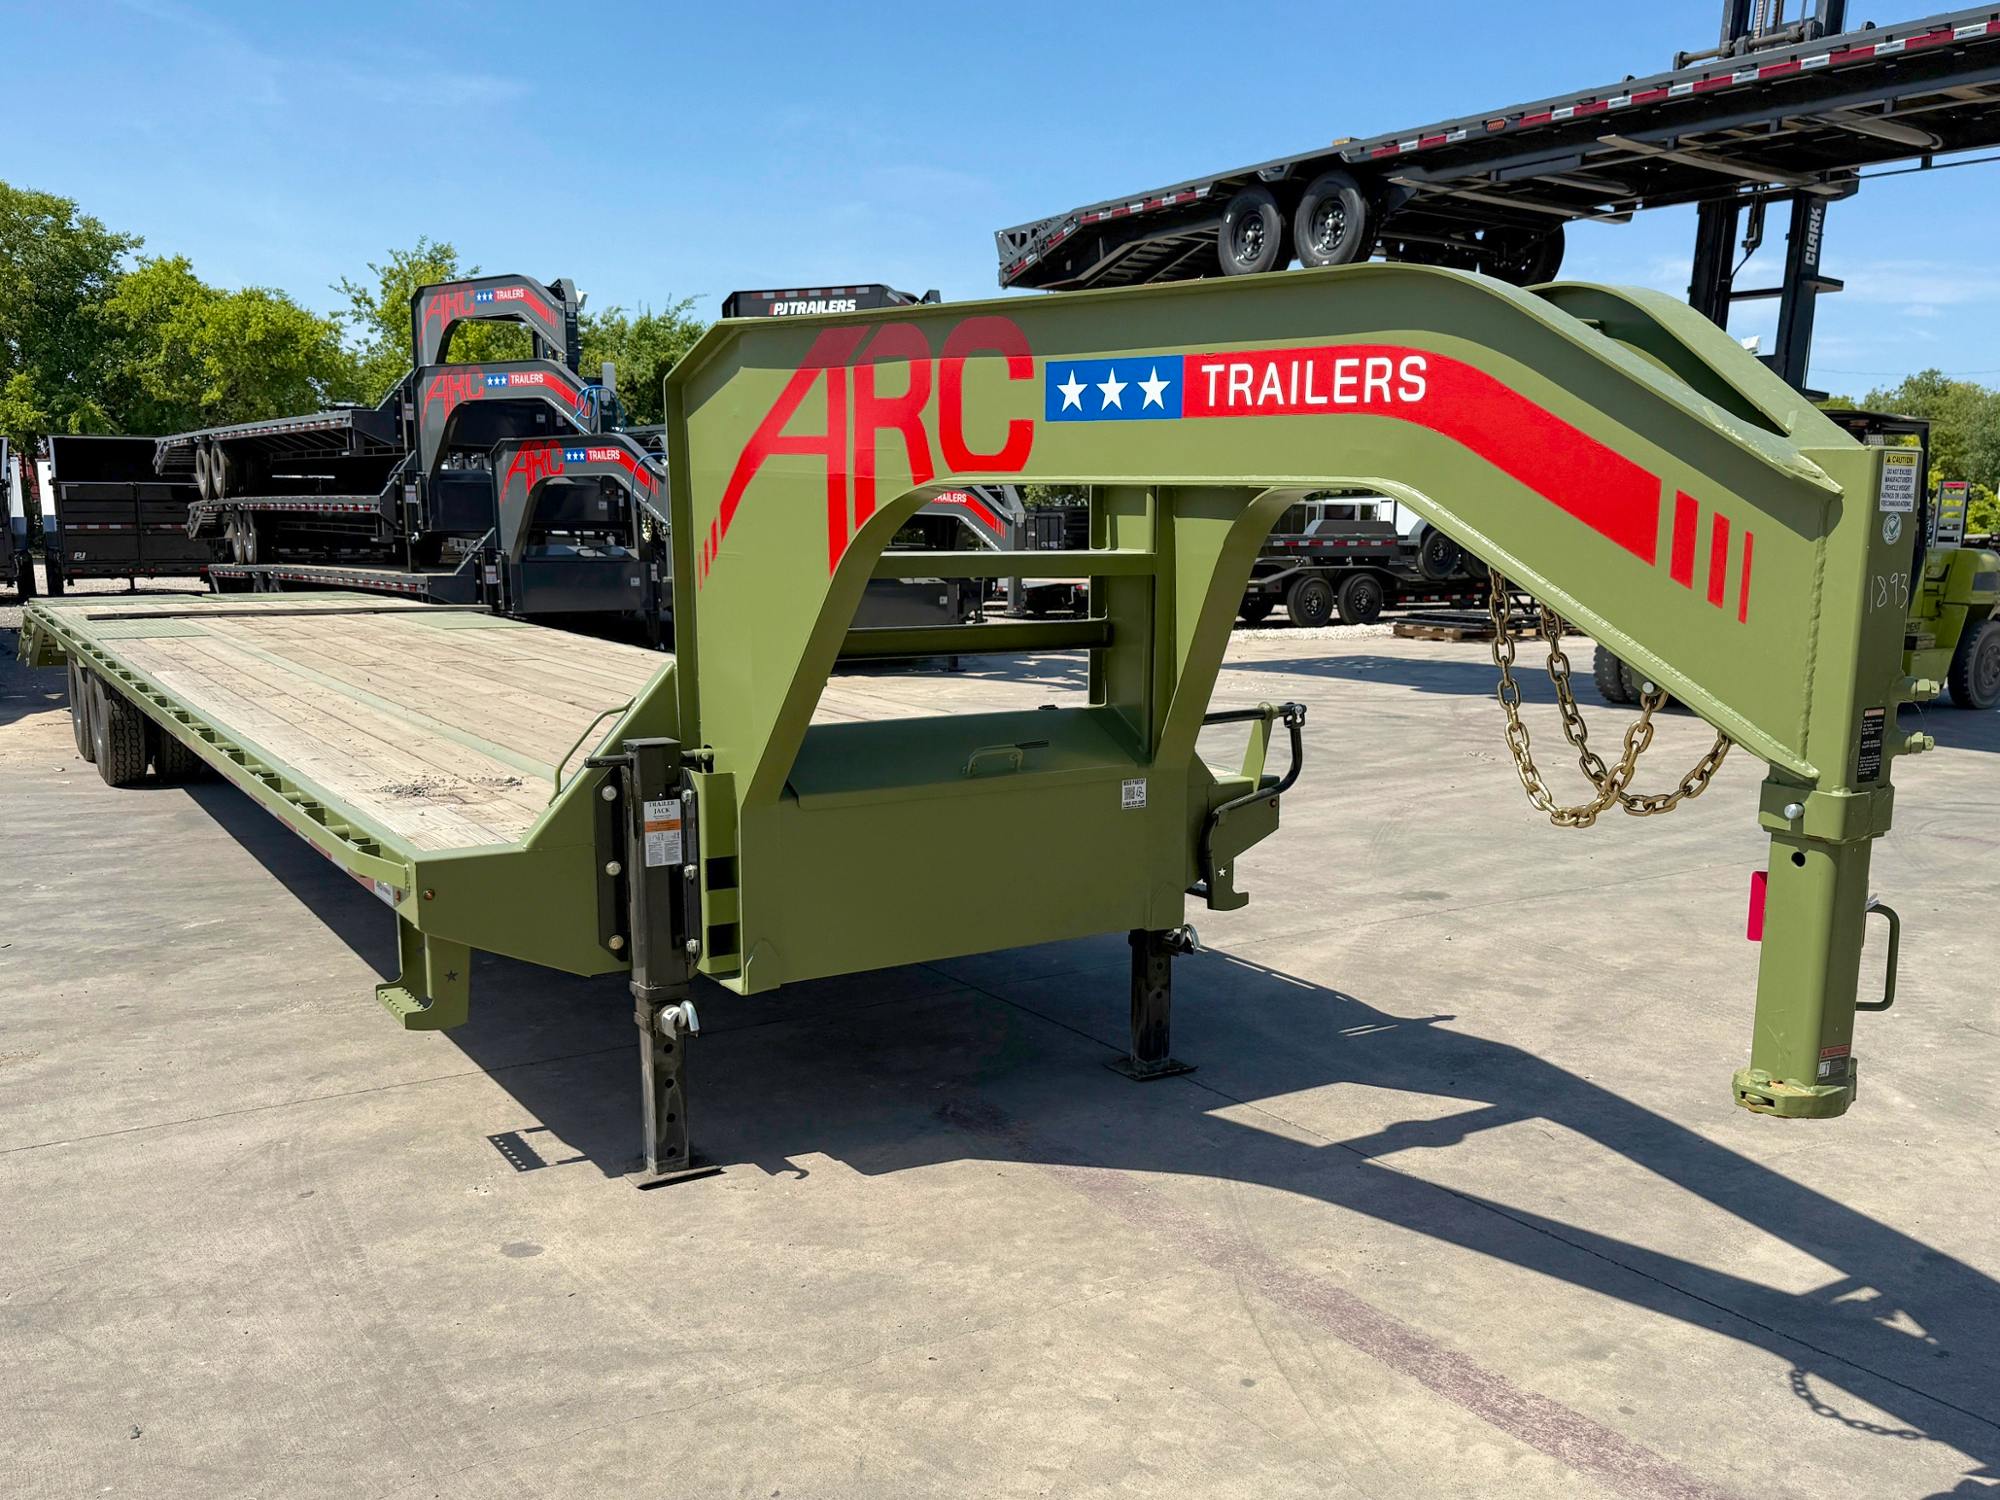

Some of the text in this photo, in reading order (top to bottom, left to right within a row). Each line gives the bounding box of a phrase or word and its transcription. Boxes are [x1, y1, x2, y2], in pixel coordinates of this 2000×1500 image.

[1805, 207, 1822, 266] CLARK
[420, 284, 525, 338] ARC TRAILERS
[421, 366, 544, 424] ARC TRAILERS
[500, 440, 620, 500] ARC TRAILERS
[706, 315, 1428, 578] ARC TRAILERS
[1892, 455, 1914, 464] CAUTION
[1870, 572, 1909, 616] 1893
